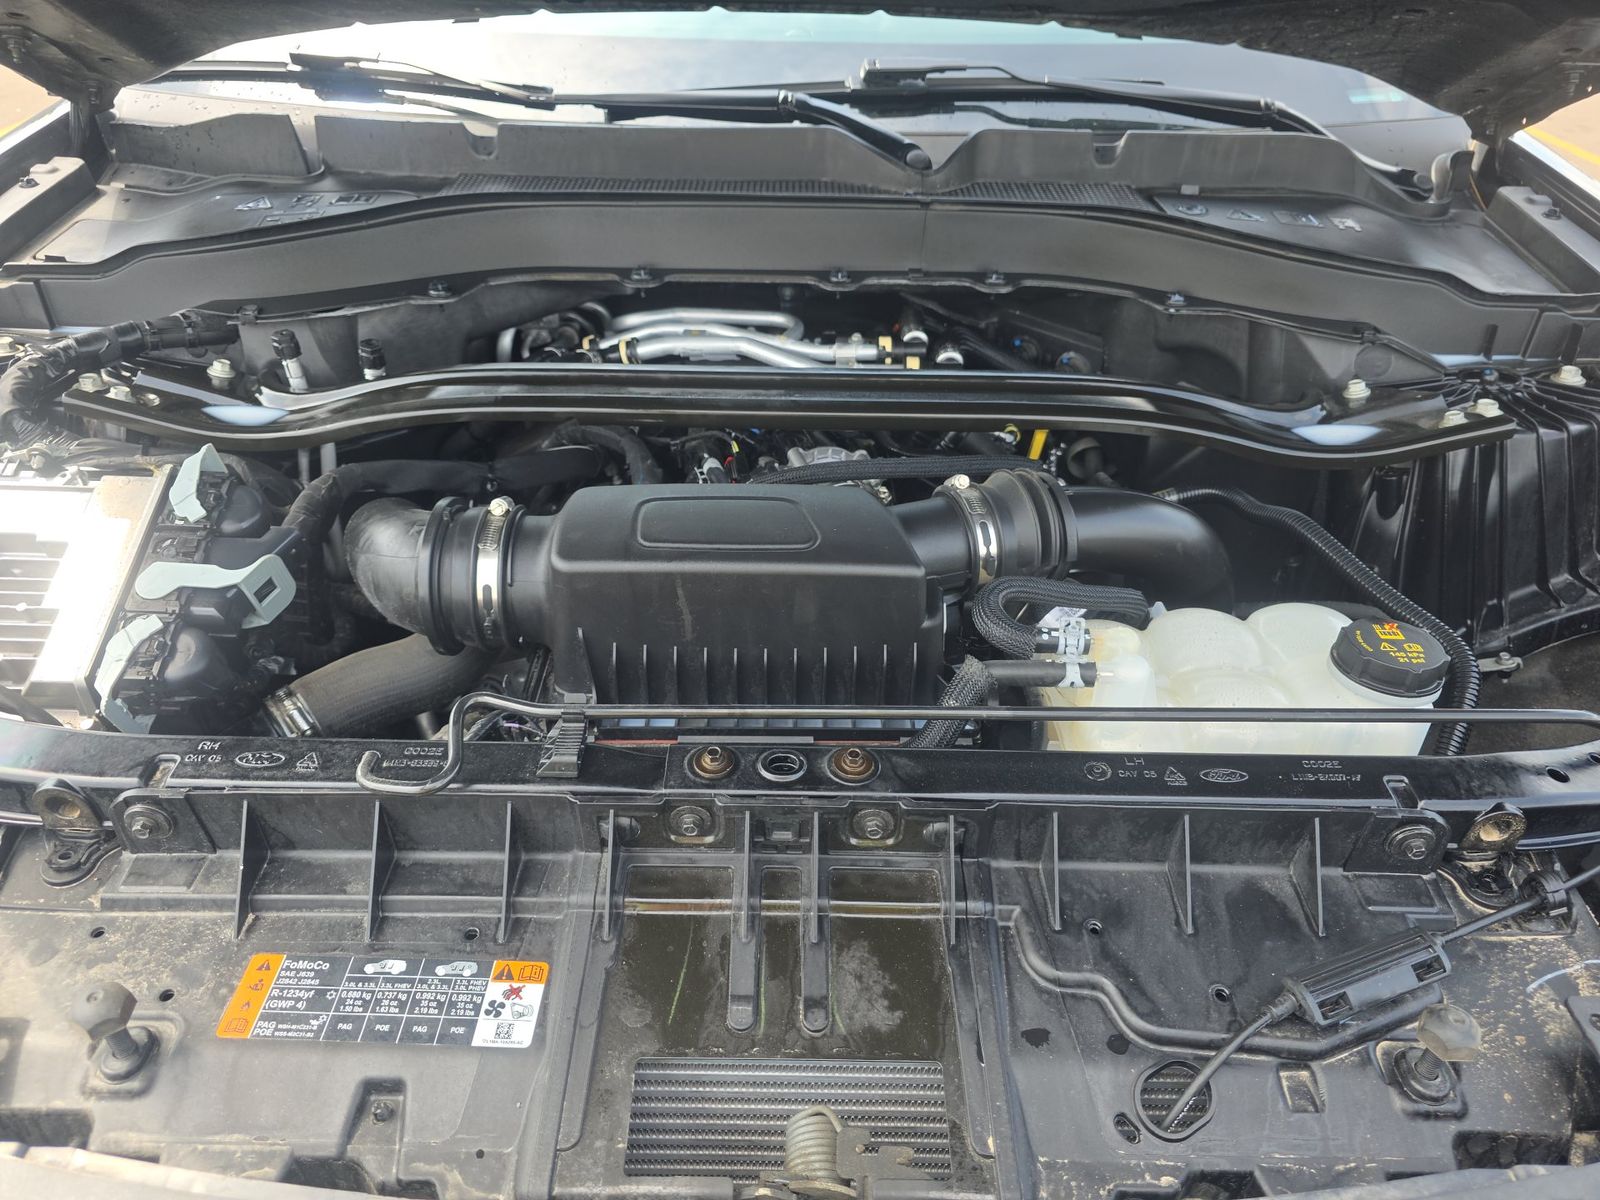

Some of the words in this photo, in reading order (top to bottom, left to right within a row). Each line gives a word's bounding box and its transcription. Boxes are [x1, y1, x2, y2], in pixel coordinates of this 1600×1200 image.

[1124, 757, 1145, 766] LH
[1118, 770, 1138, 778] CAV
[282, 960, 330, 970] FoMoCo
[270, 989, 315, 999] R-1234yf
[362, 991, 372, 1000] kg
[376, 991, 397, 999] 0.737
[398, 992, 407, 1001] kg
[415, 992, 436, 1000] 0.992
[436, 993, 446, 1001] kg
[472, 994, 482, 1003] kg
[265, 1000, 294, 1010] (GWP
[295, 1000, 307, 1010] 4)
[256, 1021, 276, 1029] PAG
[412, 1025, 428, 1033] PAG
[253, 1028, 274, 1036] POE
[450, 1026, 466, 1034] POE
